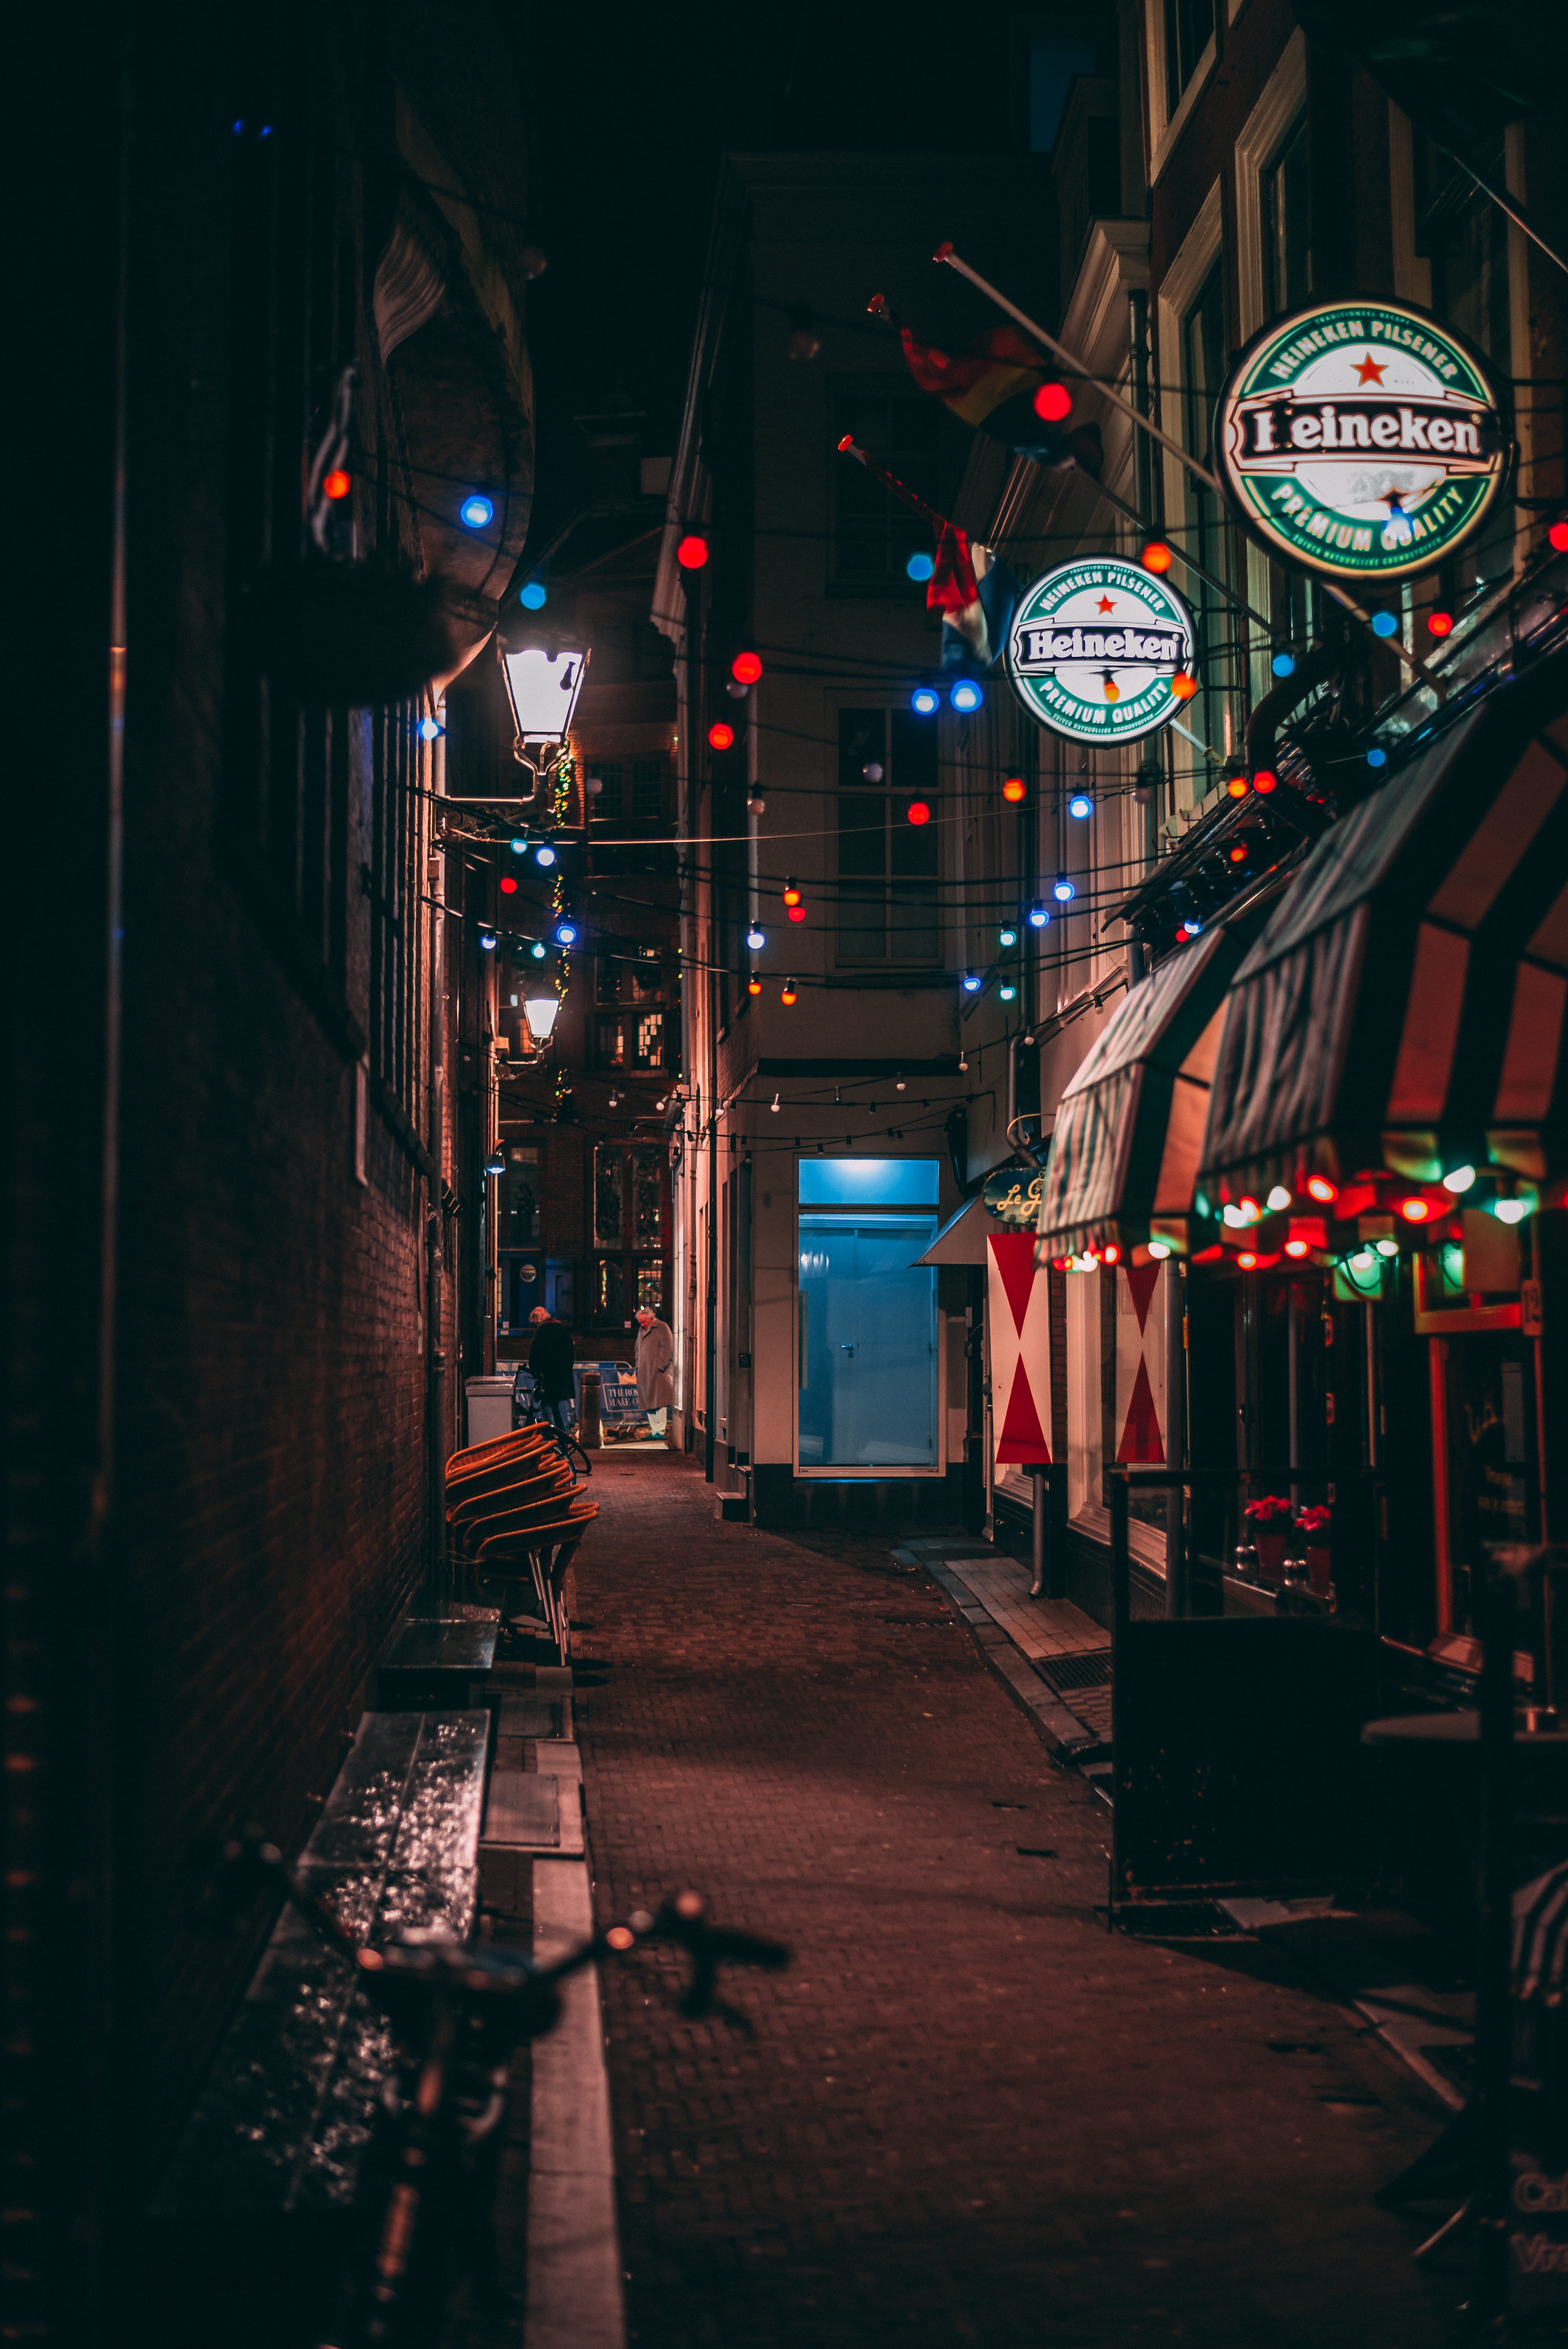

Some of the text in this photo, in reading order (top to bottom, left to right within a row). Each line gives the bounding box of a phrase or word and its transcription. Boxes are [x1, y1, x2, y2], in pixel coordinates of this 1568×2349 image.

[1270, 321, 1458, 379] HEINEKEN PILSENER
[1272, 483, 1372, 551] PREMIUM
[1039, 571, 1165, 611] HEINEKEN PILSENER
[1028, 628, 1177, 660] Heineken
[1039, 681, 1168, 724] PREMIUM QUALITY
[997, 1184, 1021, 1211] Le
[608, 1388, 624, 1397] THE
